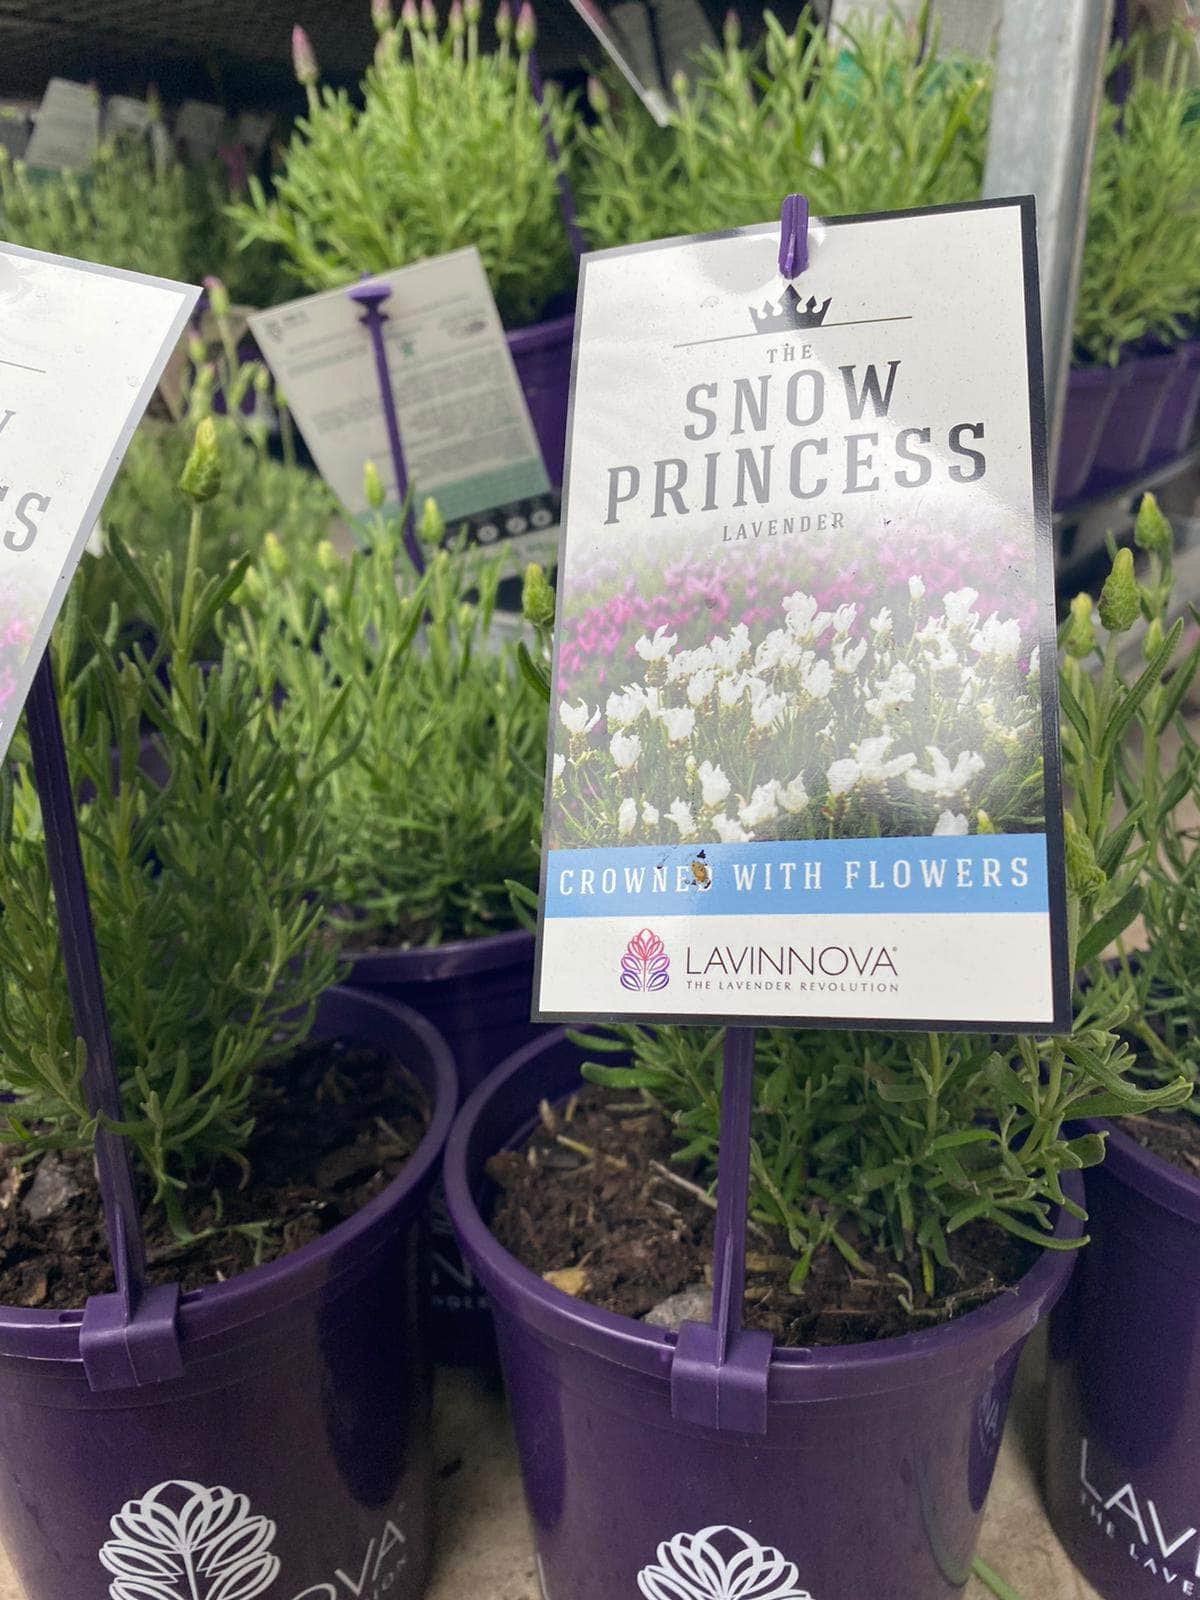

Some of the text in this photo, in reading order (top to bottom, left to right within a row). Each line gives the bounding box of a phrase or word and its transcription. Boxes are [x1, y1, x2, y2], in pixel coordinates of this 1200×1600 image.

[766, 343, 814, 364] THE
[683, 359, 902, 442] SNOW
[603, 421, 987, 525] PRINCESS
[0, 485, 52, 552] S
[722, 511, 846, 542] LAVENDER
[732, 860, 823, 891] WITH
[844, 856, 1031, 890] FLOWERS
[686, 980, 899, 993] THE LAVENDER REVOLUTION
[1079, 1437, 1200, 1578] LAV
